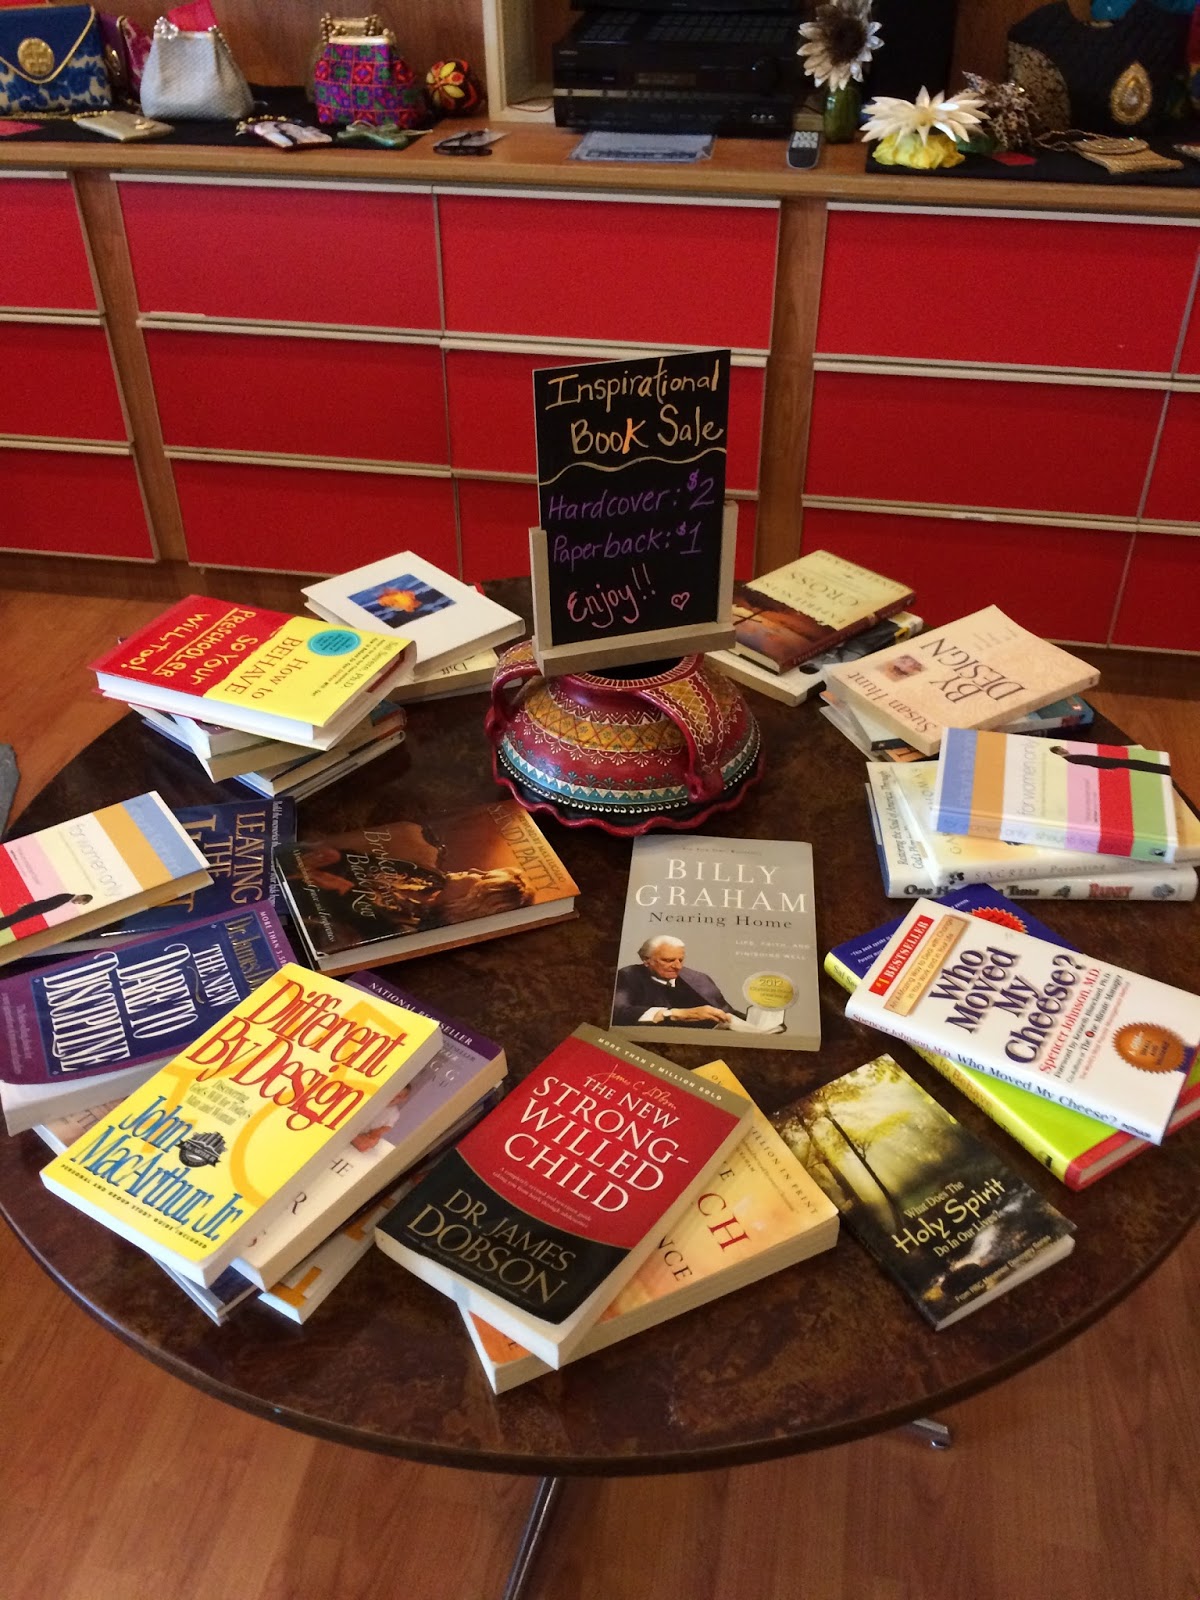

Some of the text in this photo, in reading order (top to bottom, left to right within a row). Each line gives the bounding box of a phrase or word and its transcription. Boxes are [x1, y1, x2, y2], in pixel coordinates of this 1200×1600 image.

[545, 357, 720, 413] Inspirational
[570, 403, 724, 455] Book Sale
[547, 487, 682, 521] Hardcover:
[552, 528, 672, 572] Paperback:
[566, 562, 656, 629] Enjoy!!
[223, 636, 303, 694] BEHAVE
[251, 656, 307, 699] How to
[920, 637, 1026, 703] DESIGN
[930, 676, 982, 704] BY
[846, 671, 937, 734] Susan Hunt
[203, 835, 234, 878] THE
[230, 810, 266, 904] LEAVING
[346, 852, 378, 921] Back Row
[516, 849, 560, 892] PATTY
[665, 858, 781, 885] BILLY
[635, 884, 808, 913] GRAHAM
[648, 911, 793, 929] Nearing Home
[903, 884, 935, 898] One
[1005, 884, 1041, 898] Time
[116, 943, 193, 1014] DARE
[191, 943, 240, 1010] THE NEW
[881, 919, 931, 981] BESTSELLER
[928, 948, 985, 1003] Who
[43, 951, 131, 1072] DISCIPLINE
[369, 981, 417, 1014] NATIONAL
[944, 945, 1021, 1034] Moved
[992, 974, 1042, 1018] My
[1004, 953, 1087, 1064] Cheese?
[130, 1003, 199, 1039] TO
[186, 1015, 259, 1083] By
[245, 979, 406, 1082] Different
[1037, 1029, 1071, 1076] Spencer
[1060, 985, 1093, 1031] Johnson,
[228, 1037, 365, 1133] Design
[597, 1037, 621, 1052] MORE
[624, 1050, 647, 1065] THAN
[658, 1066, 696, 1089] MILLION
[698, 1086, 722, 1102] SOLD
[957, 1053, 985, 1075] Who
[987, 1066, 1033, 1090] Moved
[1035, 1083, 1058, 1100] My
[1058, 1093, 1119, 1125] Cheese?
[120, 1096, 195, 1153] John
[533, 1075, 690, 1166] STRONG-
[582, 1075, 681, 1130] THE NEW
[504, 1132, 630, 1214] CHILD
[519, 1097, 665, 1192] WILLED
[93, 1182, 107, 1193] AND
[108, 1191, 130, 1206] GROUP
[191, 1193, 244, 1242] Jr.
[891, 1178, 1006, 1254] Holy Spirit
[903, 1180, 965, 1220] What Does The
[406, 1203, 568, 1304] DOBSON
[443, 1188, 488, 1232] DR.
[484, 1216, 577, 1273] JAMES
[933, 1244, 950, 1258] Do
[949, 1238, 961, 1250] In
[957, 1228, 976, 1243] Our
